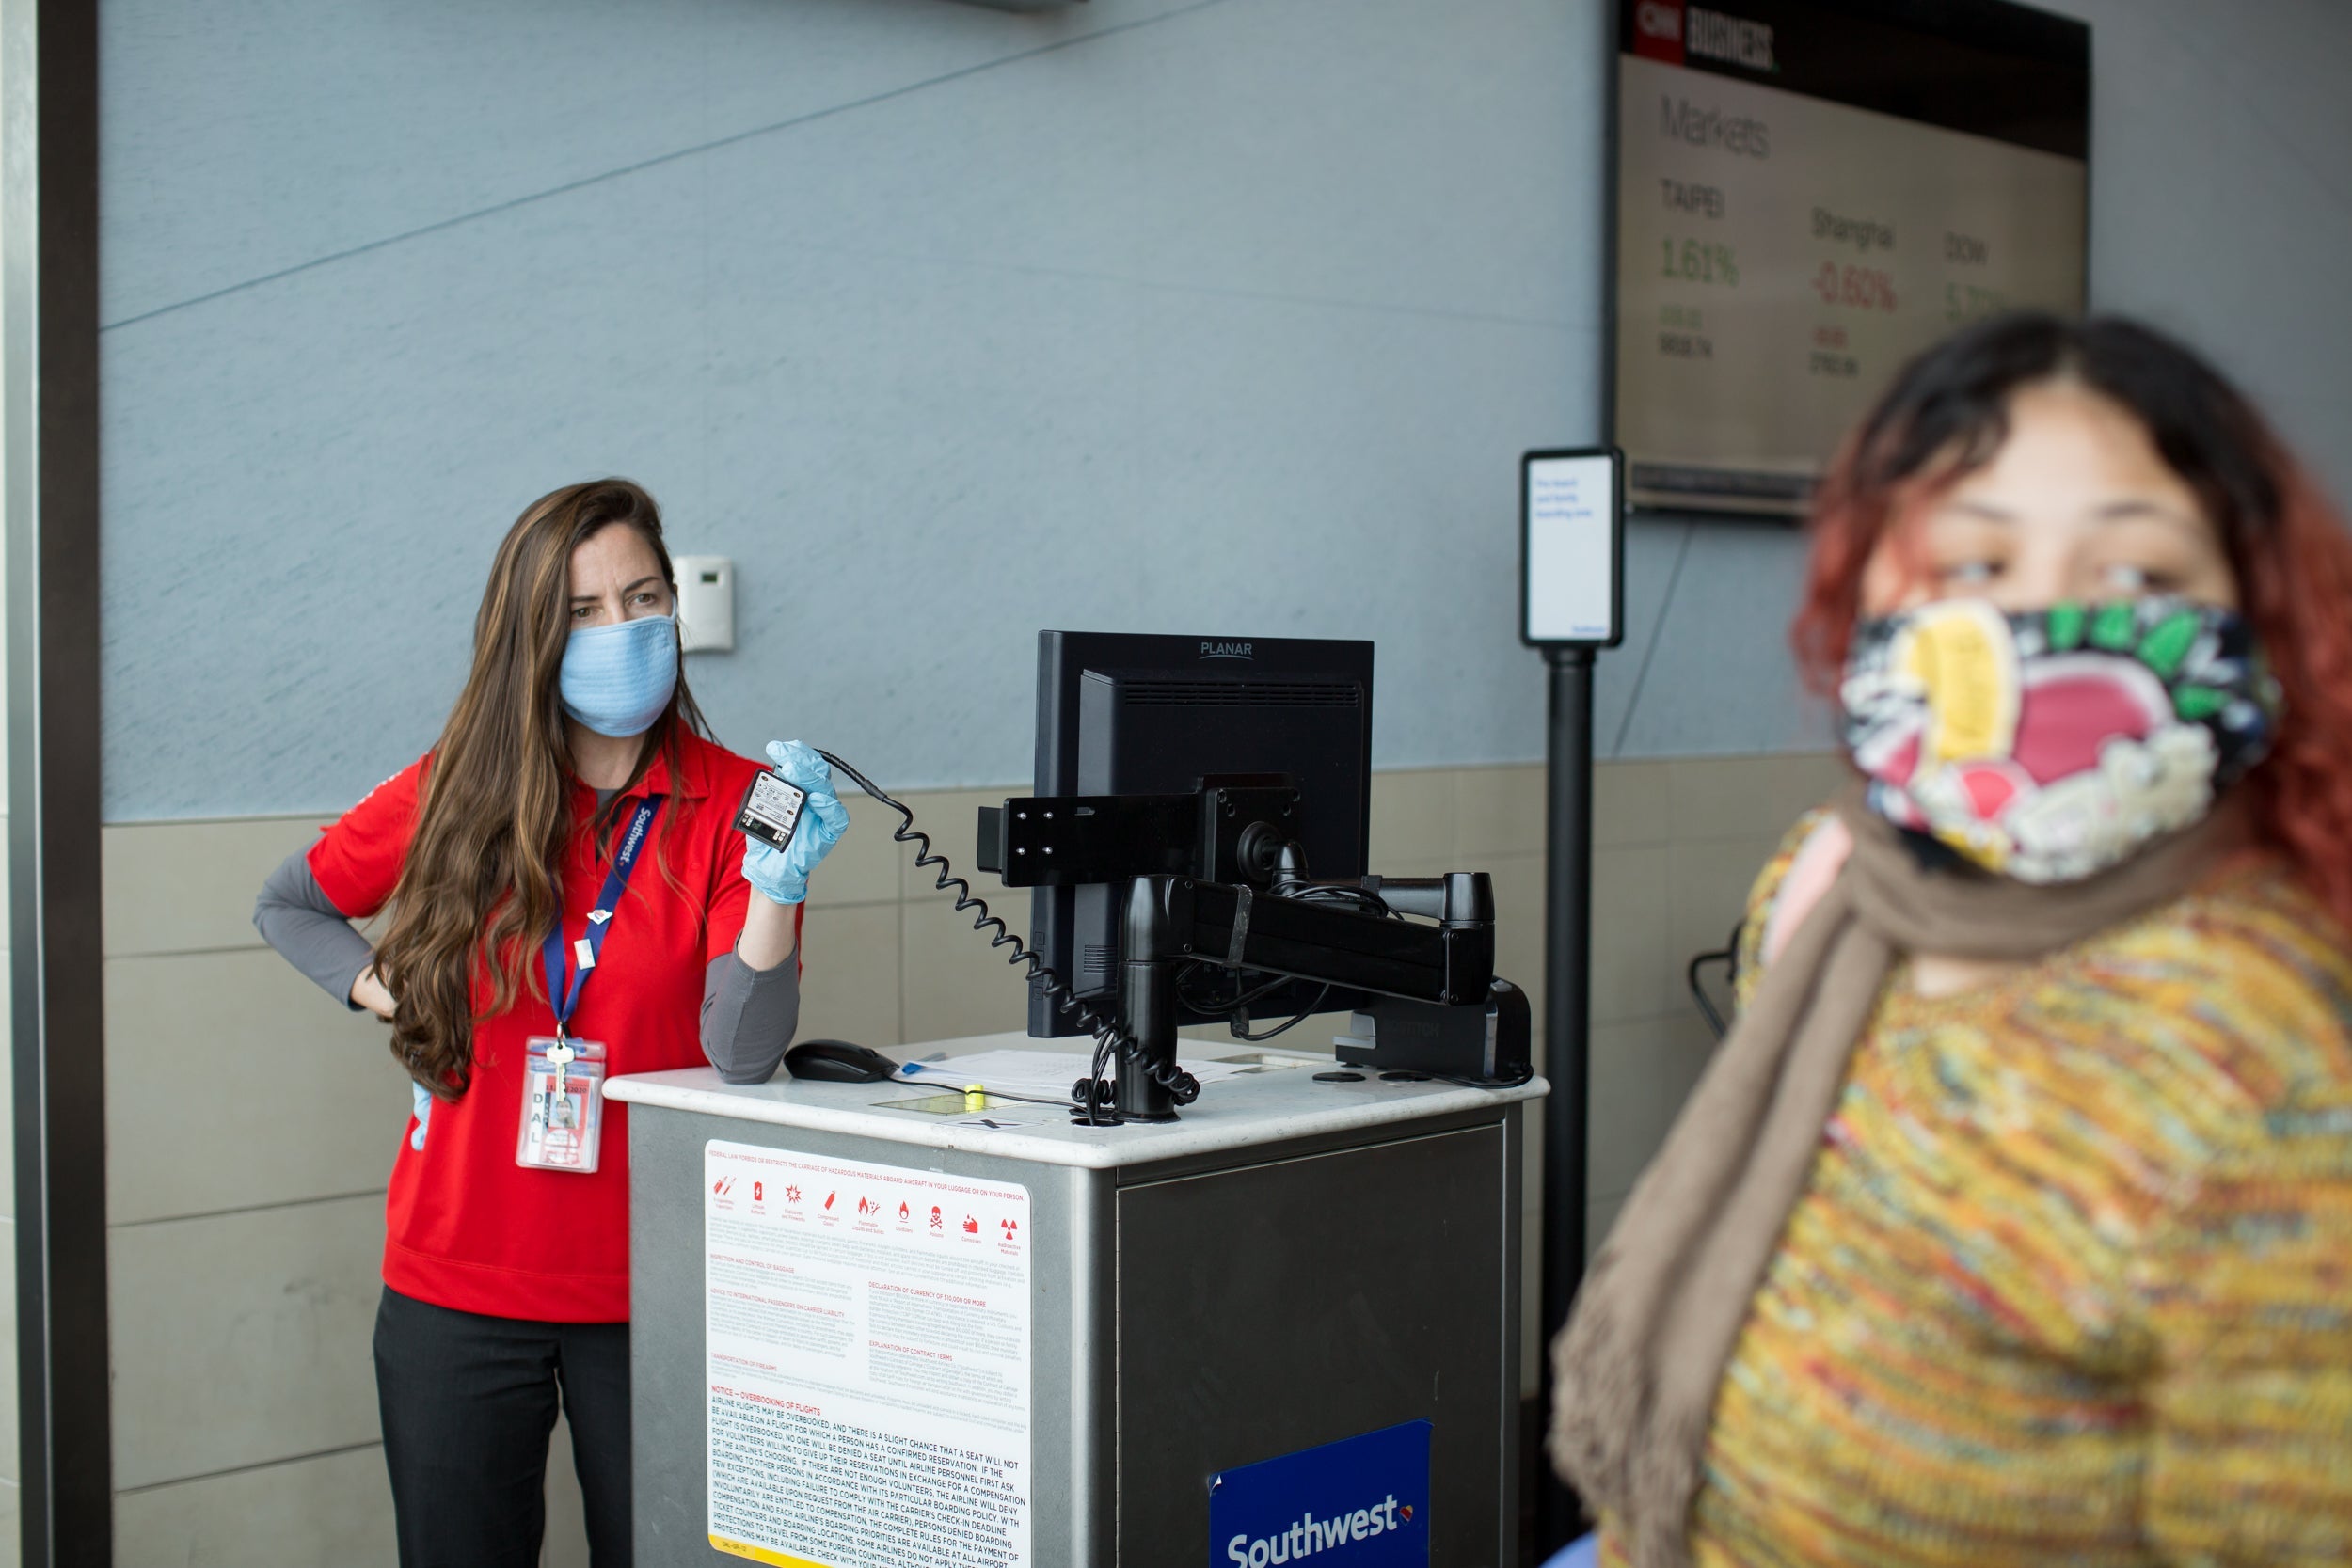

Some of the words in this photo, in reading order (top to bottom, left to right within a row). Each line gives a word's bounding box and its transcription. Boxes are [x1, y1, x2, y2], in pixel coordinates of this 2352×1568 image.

[1687, 6, 1774, 70] BUSINESS
[1660, 94, 1771, 161] Markets
[1810, 206, 1895, 253] Shanghai
[1200, 641, 1252, 656] PLANAR
[620, 807, 652, 863] Southwest
[799, 1164, 820, 1172] CARRIAGE
[829, 1167, 856, 1178] HAZARDOUS
[857, 1172, 882, 1181] MATERIALS
[883, 1175, 903, 1184] ABOARD
[904, 1179, 927, 1187] AIRCRAFT
[934, 1182, 947, 1191] YOUR
[948, 1184, 971, 1194] LUGGAGE
[989, 1190, 1002, 1198] YOUR
[1004, 1193, 1024, 1201] PERSON.
[869, 1281, 901, 1292] DECLARATION
[911, 1289, 935, 1298] CURRENCY
[944, 1294, 963, 1304] $10,000
[972, 1299, 986, 1307] MORE
[869, 1340, 901, 1353] EXPLANATION
[911, 1348, 936, 1359] CONTRACT
[937, 1354, 952, 1362] TERMS
[711, 1386, 734, 1397] NOTICE
[739, 1391, 785, 1408] OVERBOOKING
[785, 1401, 794, 1410] OF
[795, 1403, 821, 1416] FLIGHTS
[712, 1397, 734, 1409] AIRLINE
[737, 1402, 760, 1415] FLIGHTS
[762, 1407, 774, 1418] MAY
[777, 1410, 784, 1419] BE
[833, 1422, 846, 1433] AND
[849, 1426, 868, 1437] THERE
[870, 1431, 876, 1439] IS
[884, 1433, 907, 1446] SLIGHT
[910, 1439, 937, 1452] CHANCE
[940, 1446, 957, 1457] THAT
[966, 1450, 983, 1463] SEAT
[985, 1455, 1001, 1466] WILL
[1004, 1459, 1018, 1470] NOT
[712, 1407, 719, 1416] BE
[722, 1409, 754, 1423] AVAILABLE
[755, 1417, 764, 1426] ON
[772, 1420, 793, 1432] FLIGHT
[795, 1425, 807, 1435] FOR
[809, 1428, 831, 1440] WHICH
[838, 1434, 864, 1448] PERSON
[866, 1440, 879, 1450] HAS
[887, 1445, 927, 1461] CONFIRMED
[929, 1454, 977, 1472] RESERVATION.
[982, 1465, 988, 1475] IF
[991, 1467, 1003, 1478] THE
[712, 1418, 731, 1429] FLIGHT
[734, 1422, 739, 1431] IS
[786, 1433, 795, 1443] NO
[797, 1436, 809, 1447] ONE
[812, 1439, 826, 1450] WILL
[829, 1443, 836, 1452] BE
[838, 1446, 862, 1458] DENIED
[870, 1452, 886, 1464] SEAT
[888, 1456, 907, 1468] UNTIL
[910, 1461, 935, 1474] AIRLINE
[938, 1467, 978, 1484] PERSONNEL
[980, 1477, 998, 1488] FIRST
[1001, 1481, 1014, 1492] ASK
[712, 1428, 723, 1438] FOR
[726, 1432, 764, 1447] VOLUNTEERS
[767, 1440, 791, 1453] WILLING
[794, 1447, 802, 1455] TO
[803, 1449, 818, 1459] GIVE
[819, 1452, 827, 1462] UP
[830, 1454, 847, 1465] THEIR
[850, 1459, 898, 1477] RESERVATIONS
[900, 1470, 907, 1480] IN
[909, 1472, 946, 1488] EXCHANGE
[948, 1481, 961, 1492] FOR
[971, 1486, 1025, 1506] COMPENSATION
[712, 1438, 720, 1448] OF
[723, 1441, 733, 1450] THE
[802, 1459, 806, 1467] IF
[809, 1461, 828, 1472] THERE
[831, 1465, 843, 1476] ARE
[844, 1468, 857, 1480] NOT
[860, 1472, 887, 1486] ENOUGH
[889, 1479, 934, 1497] VOLUNTEERS,
[937, 1489, 949, 1500] THE
[952, 1493, 978, 1507] AIRLINE
[980, 1499, 996, 1511] WILL
[999, 1503, 1017, 1515] DENY
[712, 1449, 743, 1464] BOARDING
[746, 1457, 753, 1466] TO
[755, 1459, 775, 1471] OTHER
[776, 1464, 804, 1478] PERSONS
[806, 1470, 813, 1480] IN
[815, 1473, 858, 1490] ACCORDANCE
[861, 1483, 877, 1495] WITH
[879, 1487, 888, 1497] ITS
[890, 1490, 932, 1508] PARTICULAR
[934, 1500, 970, 1516] BOARDING
[972, 1509, 998, 1523] POLICY.
[1001, 1515, 1019, 1528] WITH
[713, 1460, 725, 1470] FEW
[767, 1472, 800, 1488] INCLUDING
[803, 1481, 828, 1494] FAILURE
[830, 1487, 838, 1497] TO
[840, 1489, 866, 1503] COMPLY
[867, 1496, 884, 1508] WITH
[887, 1500, 898, 1511] THE
[900, 1503, 935, 1519] CARRIER'S
[937, 1512, 970, 1528] CHECK-IN
[972, 1520, 1006, 1536] DEADLINE
[1227, 1494, 1398, 1568] Southwest
